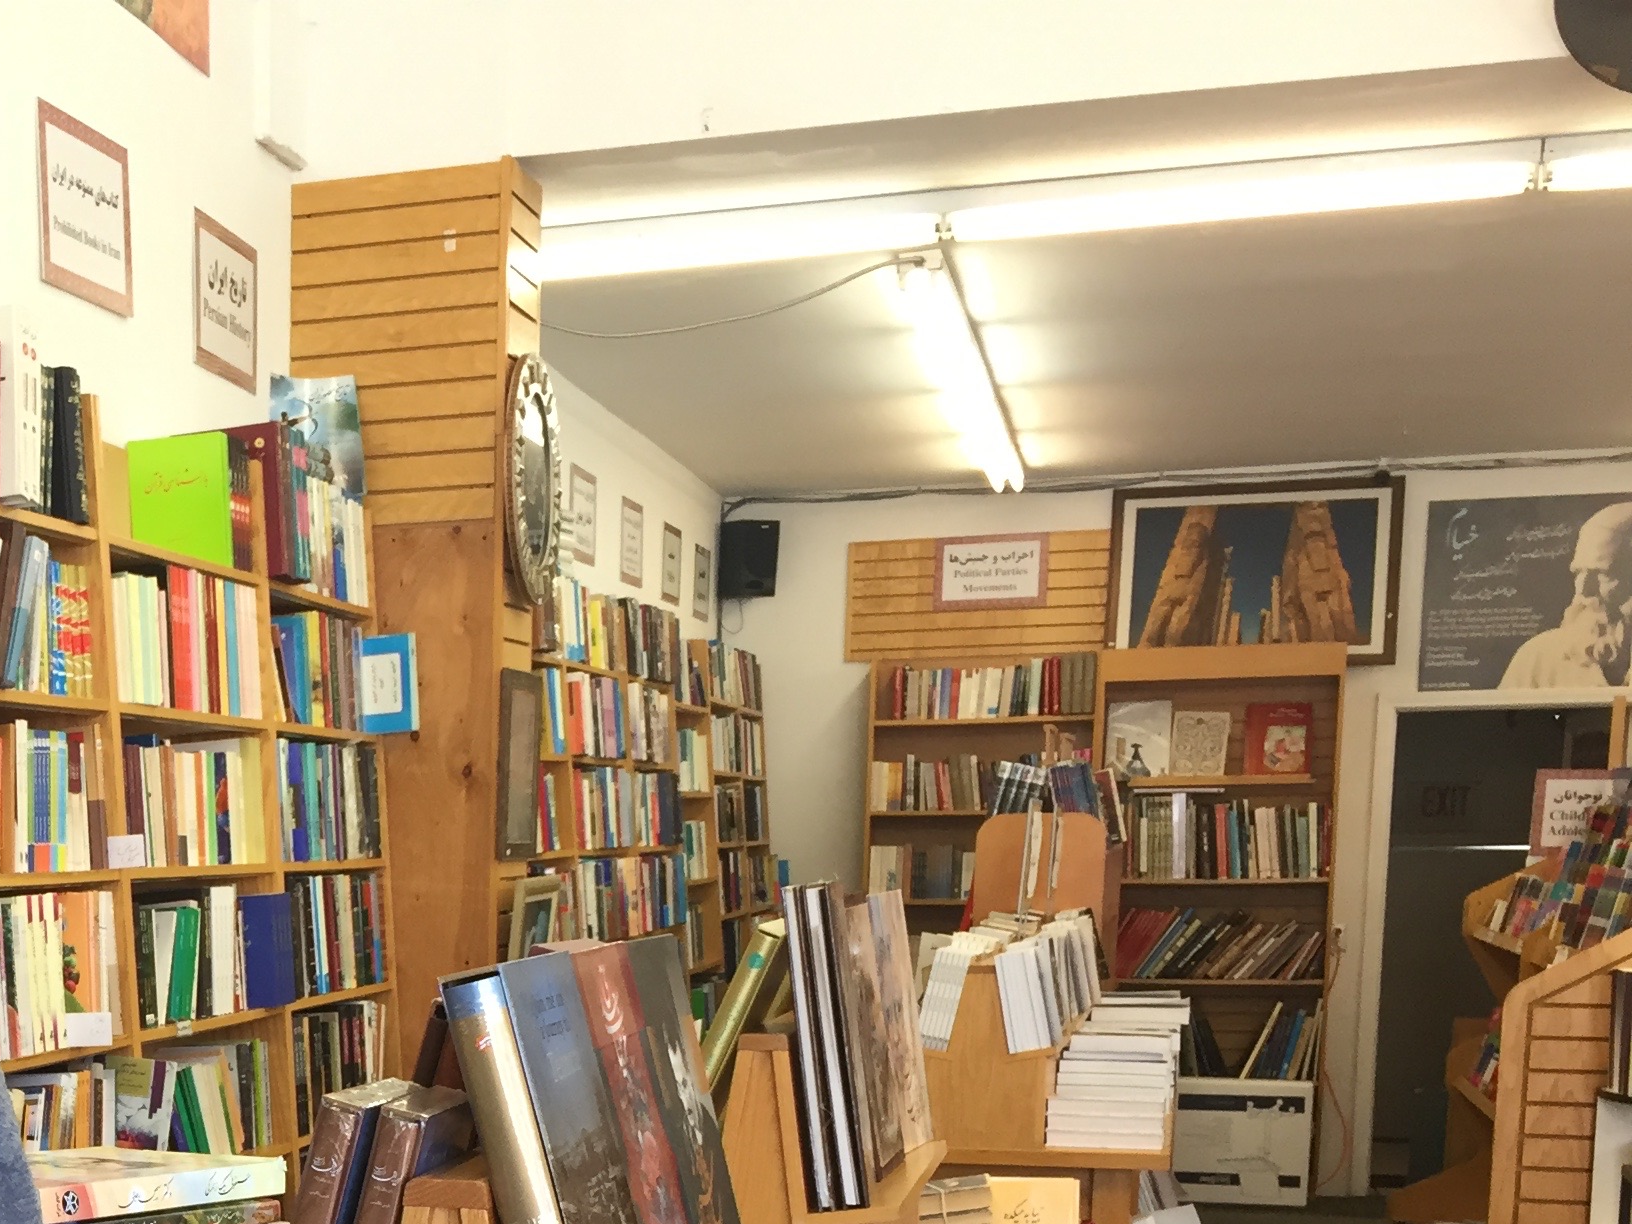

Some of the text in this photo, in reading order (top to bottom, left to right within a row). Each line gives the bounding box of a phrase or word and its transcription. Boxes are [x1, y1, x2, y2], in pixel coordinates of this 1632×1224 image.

[207, 259, 247, 308] تاریخ ایران
[203, 297, 252, 349] Persian History
[953, 567, 1029, 579] Political Parties
[962, 584, 1018, 593] Movements
